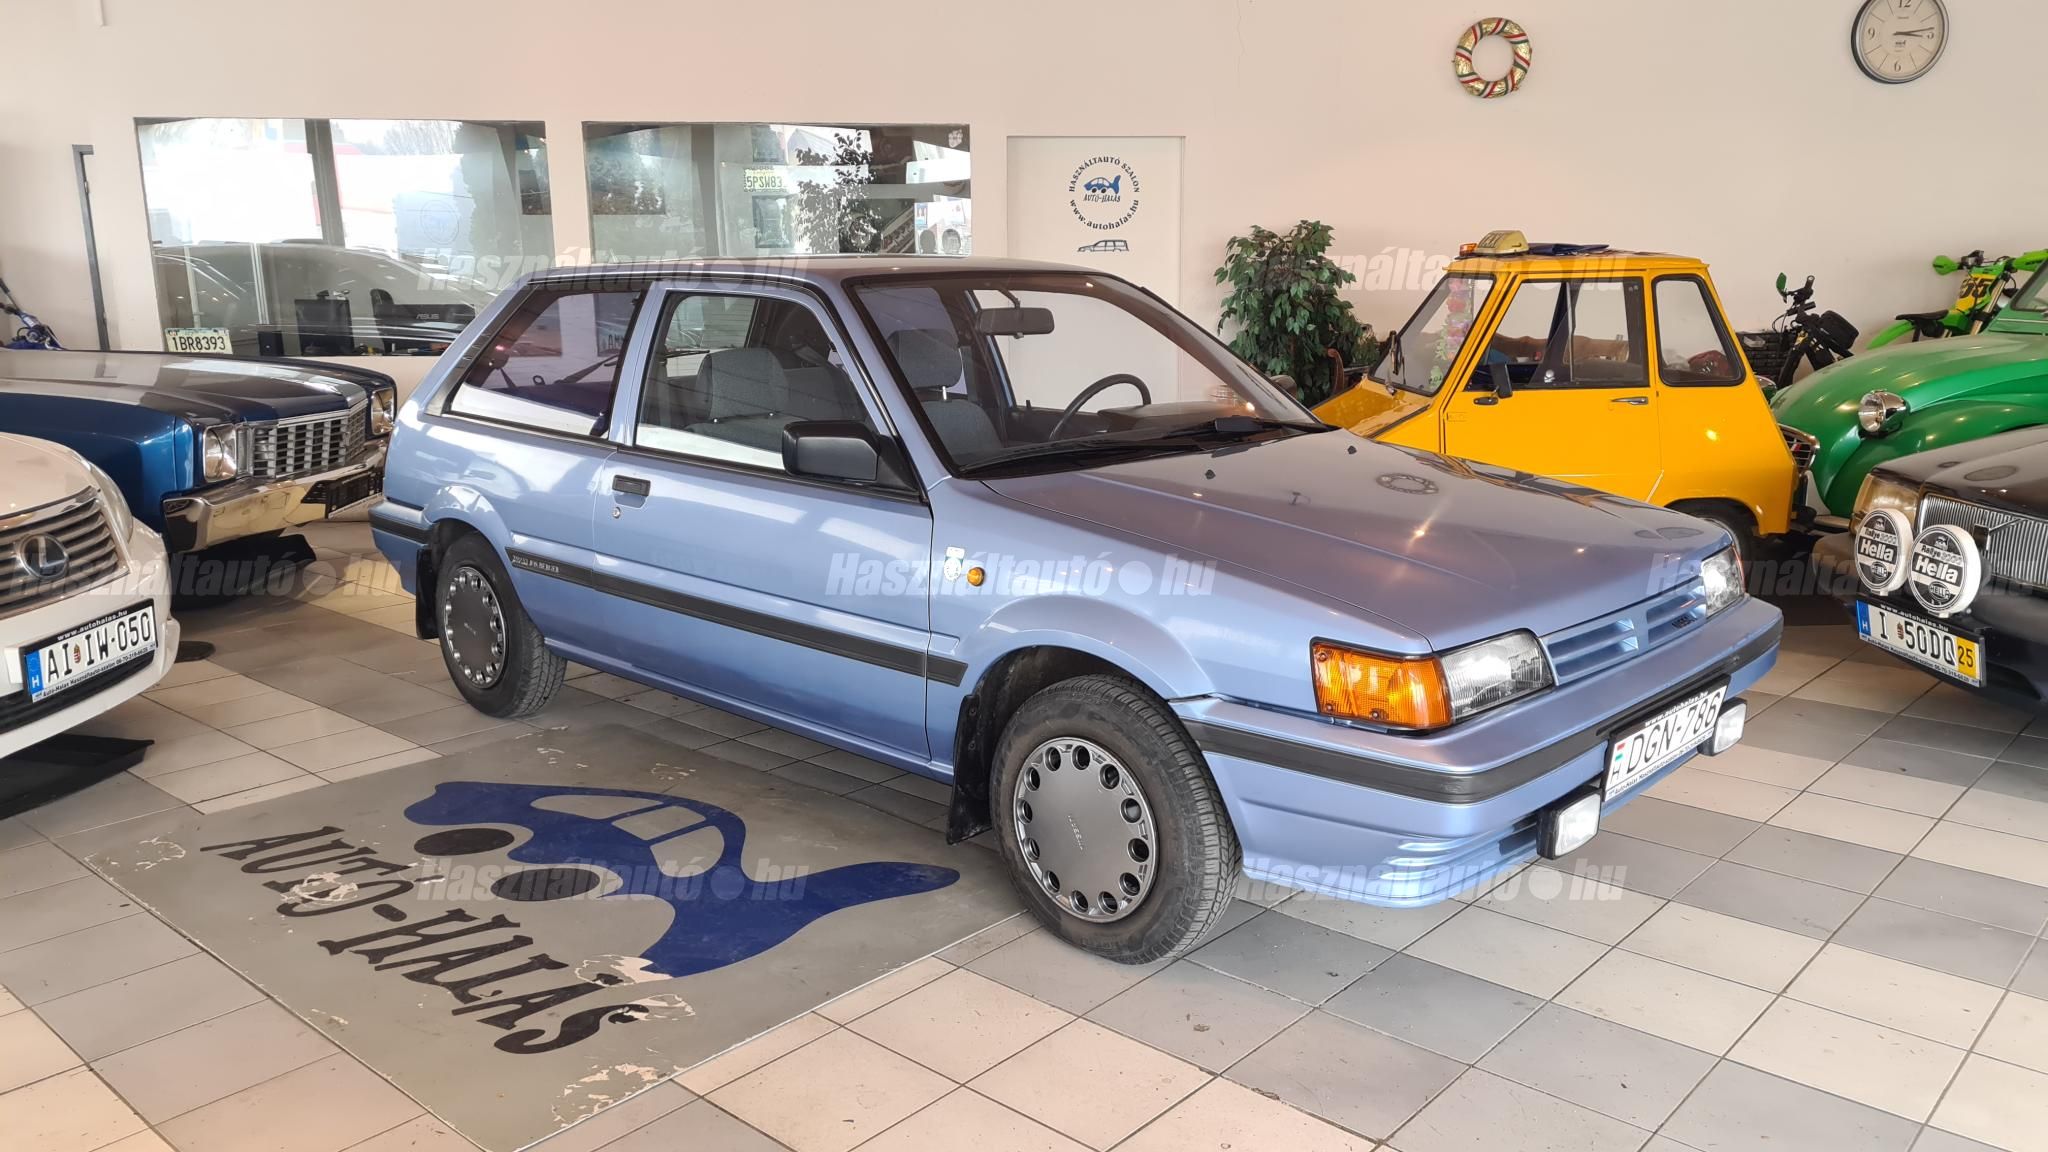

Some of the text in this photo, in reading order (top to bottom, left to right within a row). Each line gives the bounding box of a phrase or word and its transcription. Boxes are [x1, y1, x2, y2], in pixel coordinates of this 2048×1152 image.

[1867, 27, 1876, 40] 9
[1894, 61, 1902, 73] 6
[746, 175, 786, 188] 5PSW83
[1121, 163, 1140, 193] SZALON
[1069, 199, 1139, 230] www.autohalas.hu
[172, 336, 226, 351] 1BR8393
[1860, 538, 1895, 562] Hella
[1920, 544, 1941, 558] Rallye
[1915, 555, 1958, 584] Hella
[57, 609, 128, 641] www.autohalas.hu
[1862, 620, 1868, 631] H
[1880, 604, 1949, 632] www.autohalas.hu
[48, 643, 72, 683] AI
[1958, 645, 1974, 668] 25
[31, 676, 39, 688] H
[1627, 691, 1721, 774] DGN-786
[1610, 763, 1621, 784] H
